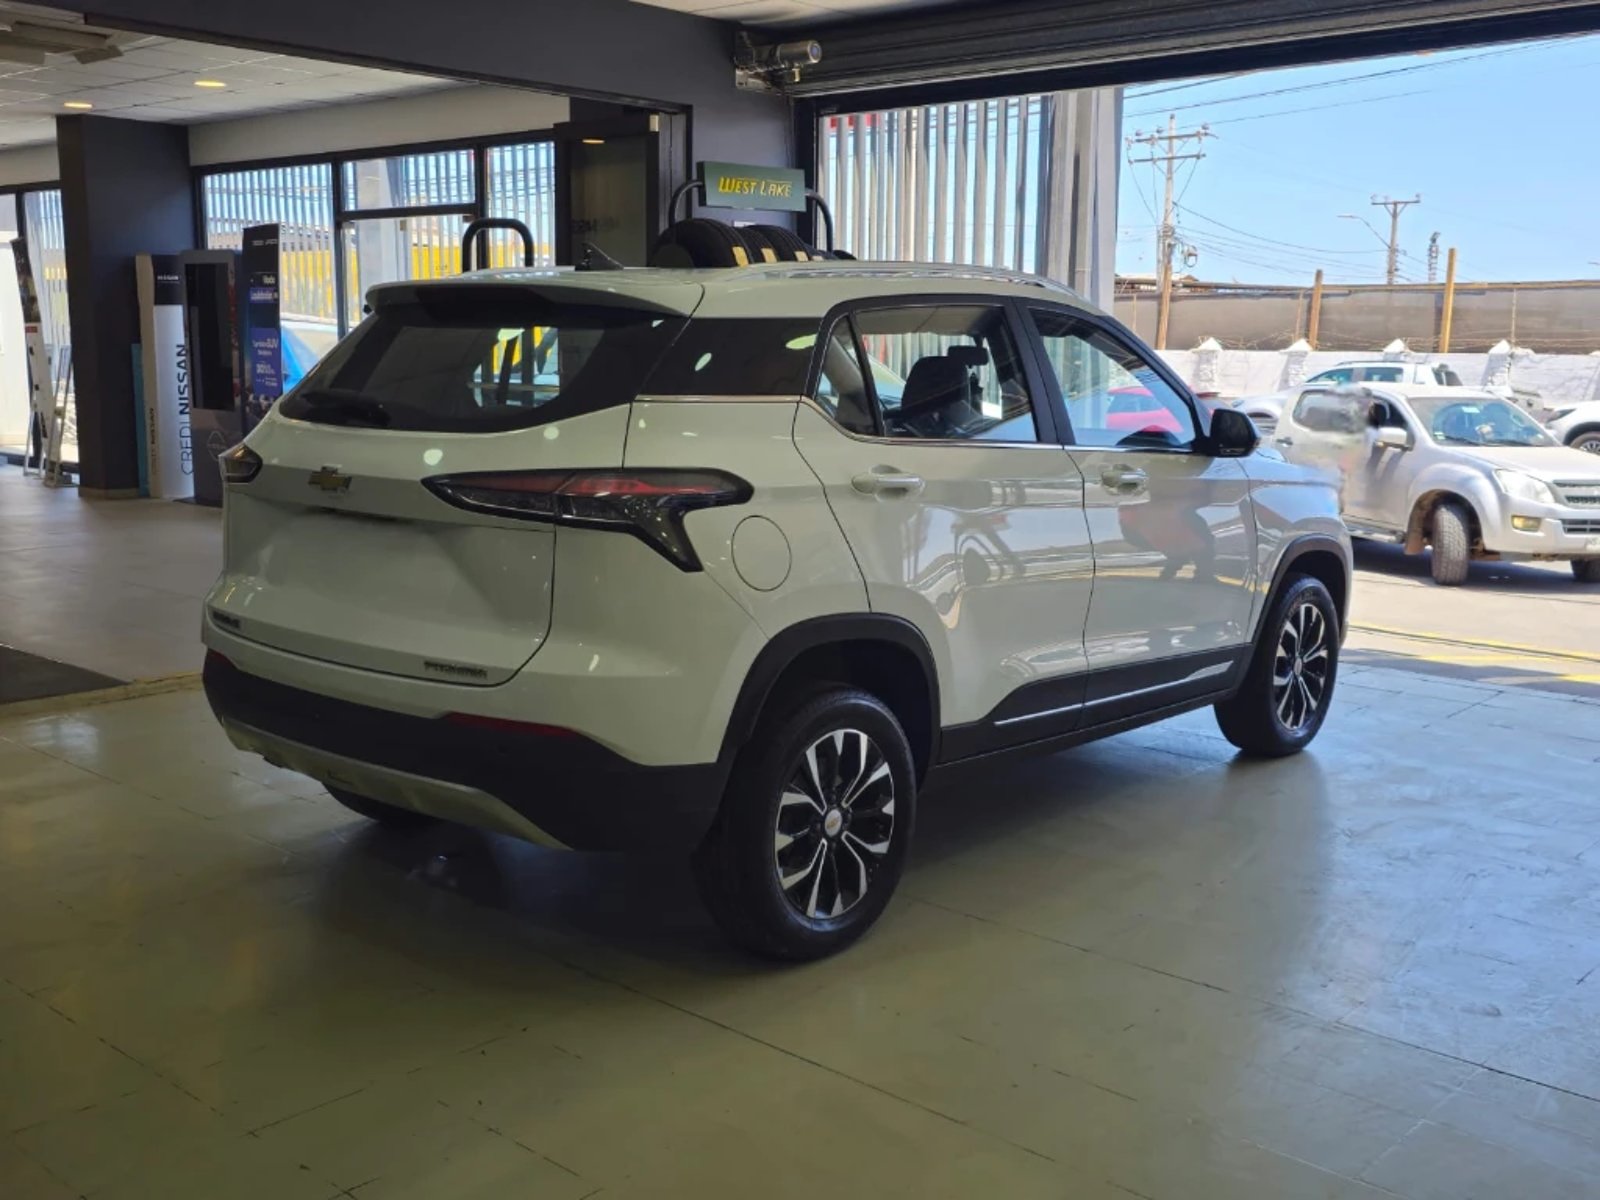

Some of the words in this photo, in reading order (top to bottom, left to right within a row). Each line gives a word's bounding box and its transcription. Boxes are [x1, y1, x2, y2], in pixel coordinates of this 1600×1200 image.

[718, 176, 756, 194] WEST
[760, 180, 793, 198] LAKE
[176, 344, 191, 415] NISSAN
